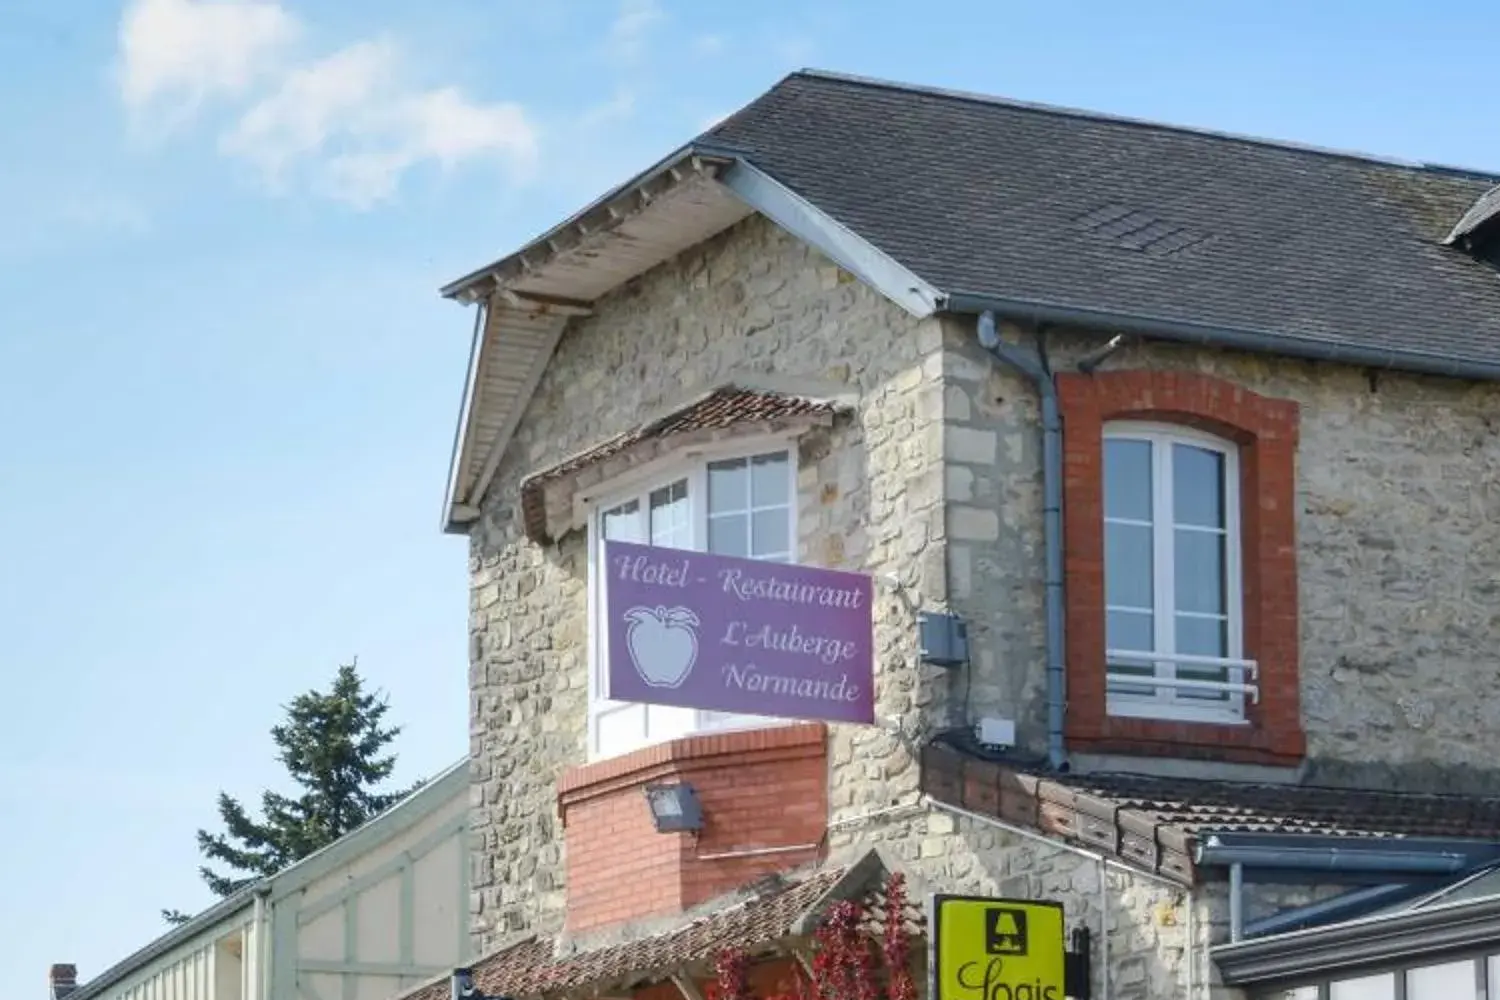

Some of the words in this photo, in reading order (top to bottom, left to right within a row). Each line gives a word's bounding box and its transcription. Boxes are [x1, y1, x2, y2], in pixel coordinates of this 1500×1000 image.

[717, 568, 864, 609] Restaurant
[721, 620, 858, 665] L'Auberge
[722, 663, 860, 702] Normande
